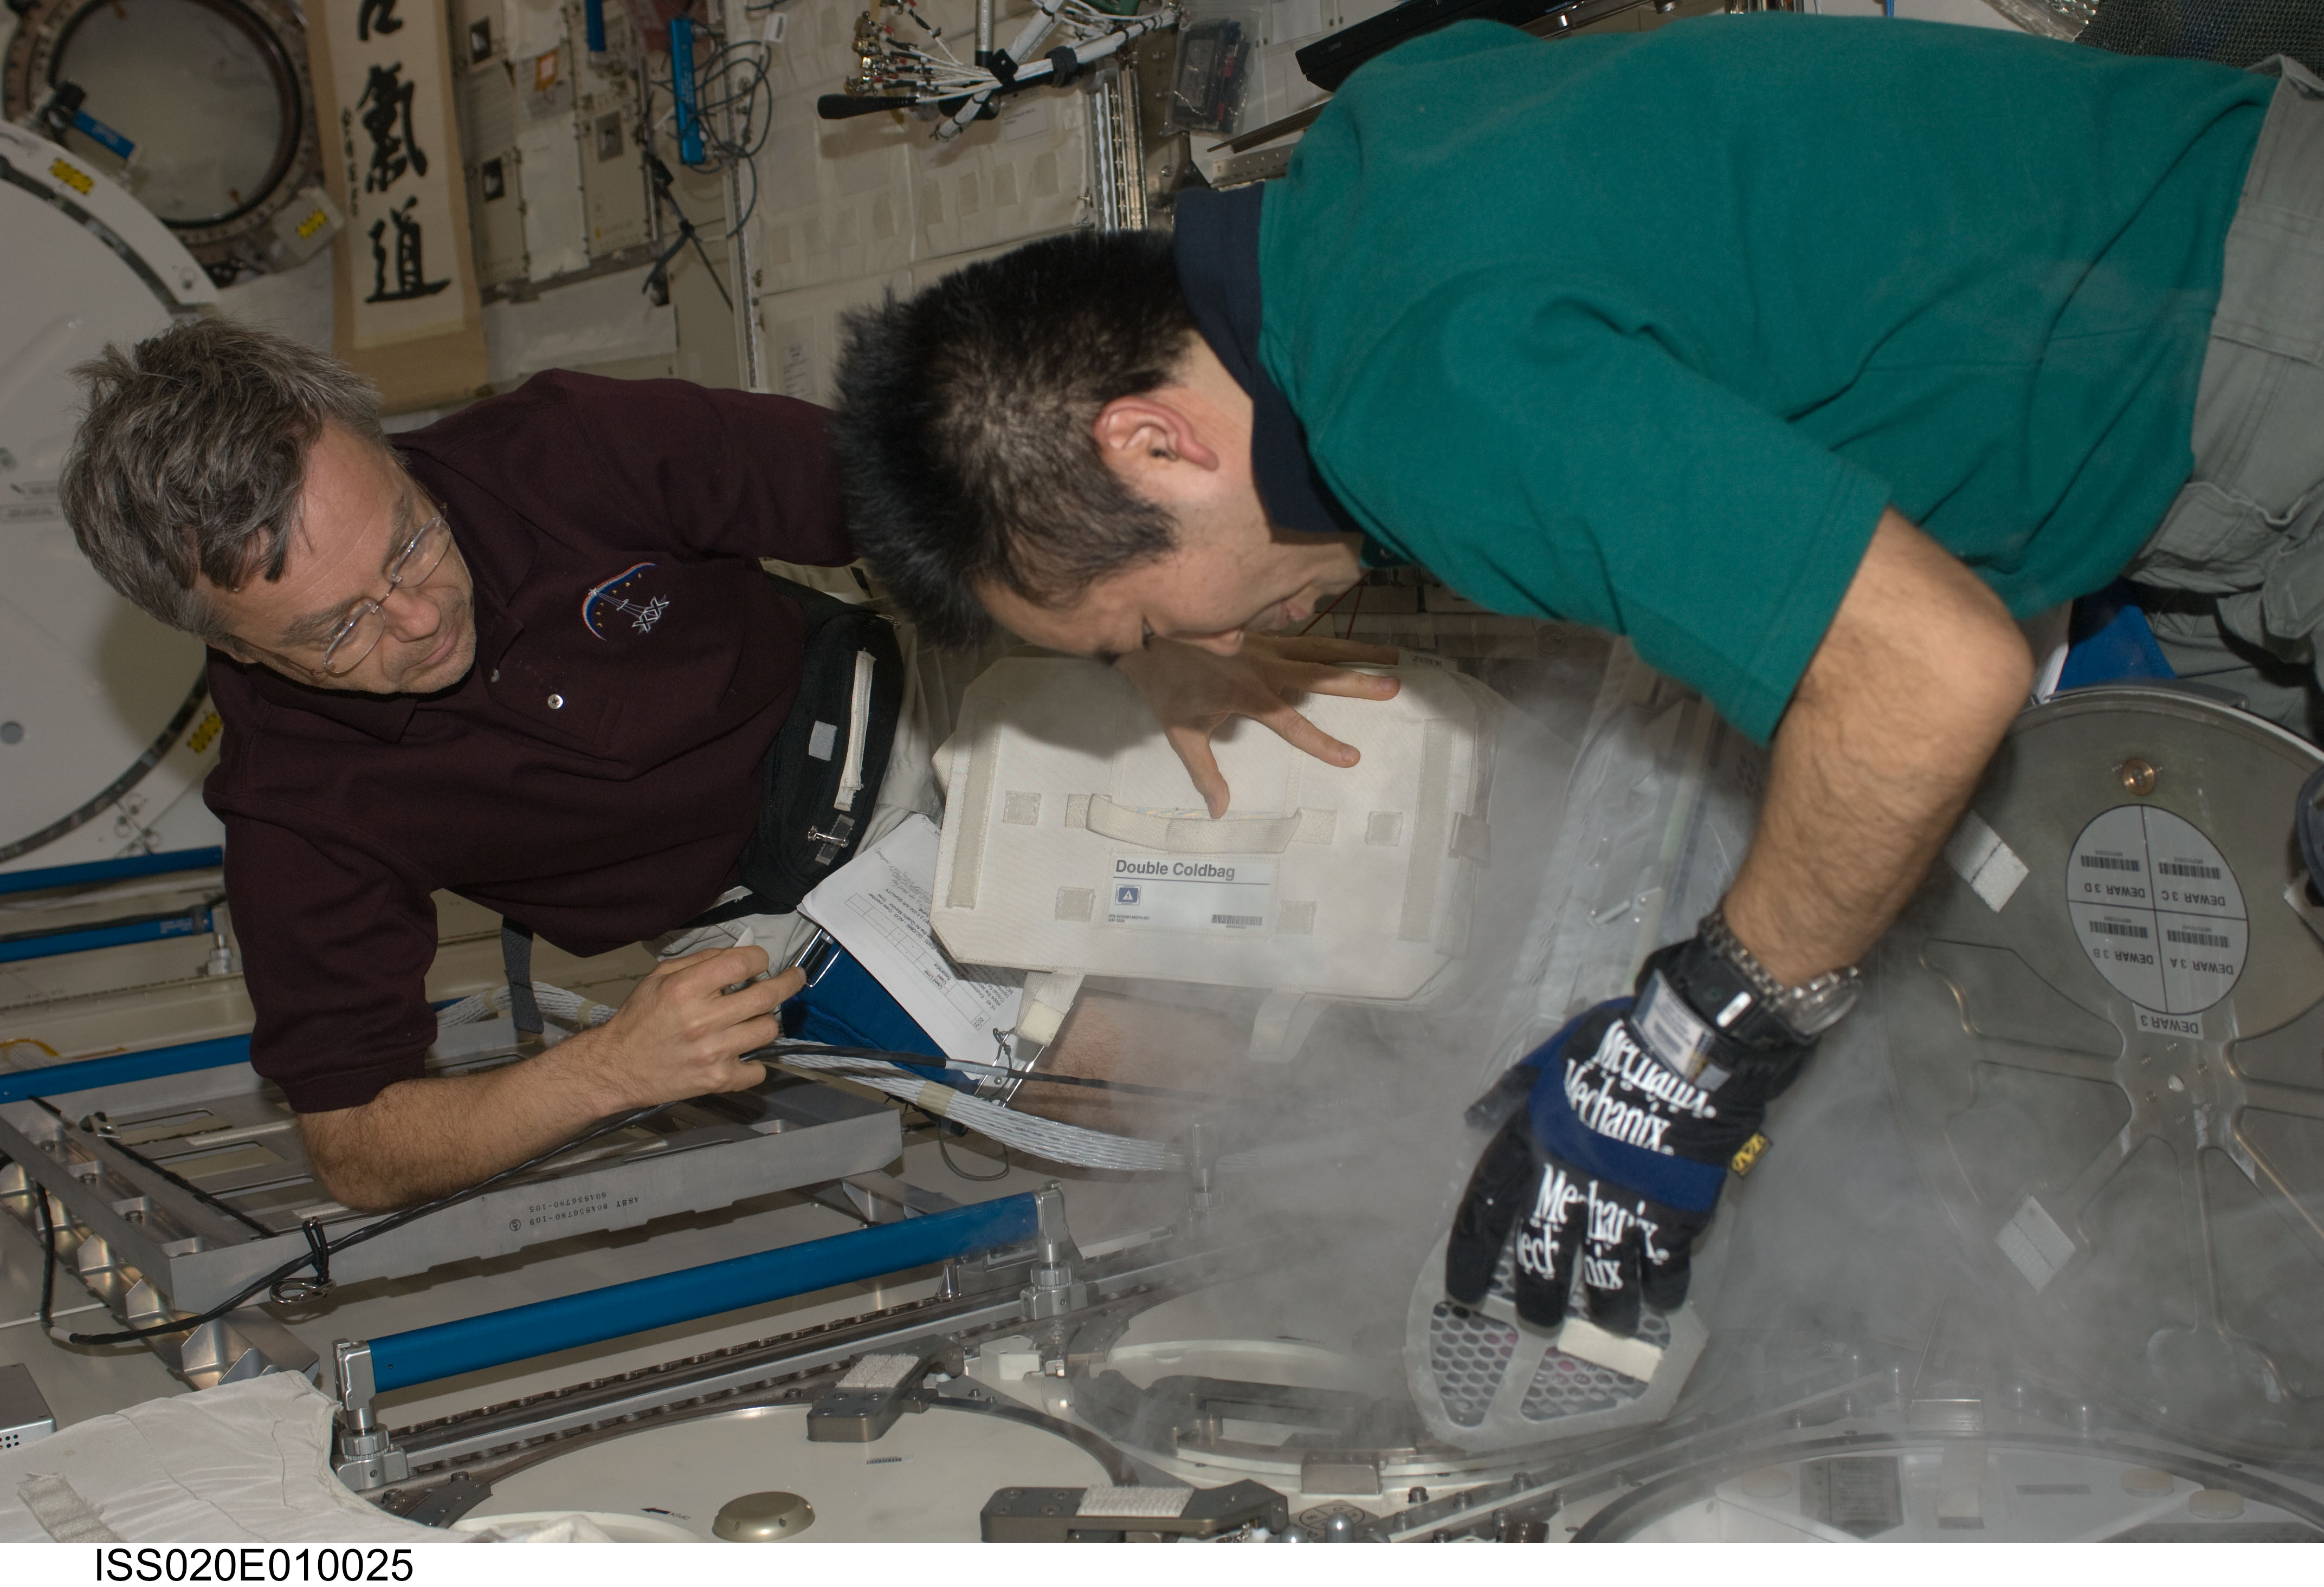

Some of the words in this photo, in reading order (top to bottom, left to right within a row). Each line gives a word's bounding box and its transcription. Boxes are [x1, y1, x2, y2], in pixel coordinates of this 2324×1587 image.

[1116, 859, 1169, 875] Double
[1173, 862, 1235, 881] Coldbag
[2084, 882, 2091, 892] D
[2094, 883, 2101, 893] 3
[2106, 883, 2145, 898] DEWAR
[884, 886, 903, 903] QUALITY
[2162, 890, 2168, 901] C
[2172, 890, 2179, 900] 3
[2184, 892, 2226, 906] DEWAR
[893, 912, 903, 922] ACO
[920, 927, 928, 935] the
[924, 937, 938, 951] (EHS)
[2093, 948, 2100, 958] B
[2103, 949, 2109, 959] 3
[2115, 950, 2154, 965] DEWAR
[2170, 957, 2178, 968] A
[2180, 959, 2187, 969] 3
[2193, 960, 2234, 975] DEWAR
[922, 968, 934, 980] Liner
[933, 961, 952, 981] Separator
[932, 977, 943, 990] Used
[936, 973, 948, 985] Used
[2140, 1014, 2147, 1026] 3
[2151, 1016, 2199, 1034] DEWAR
